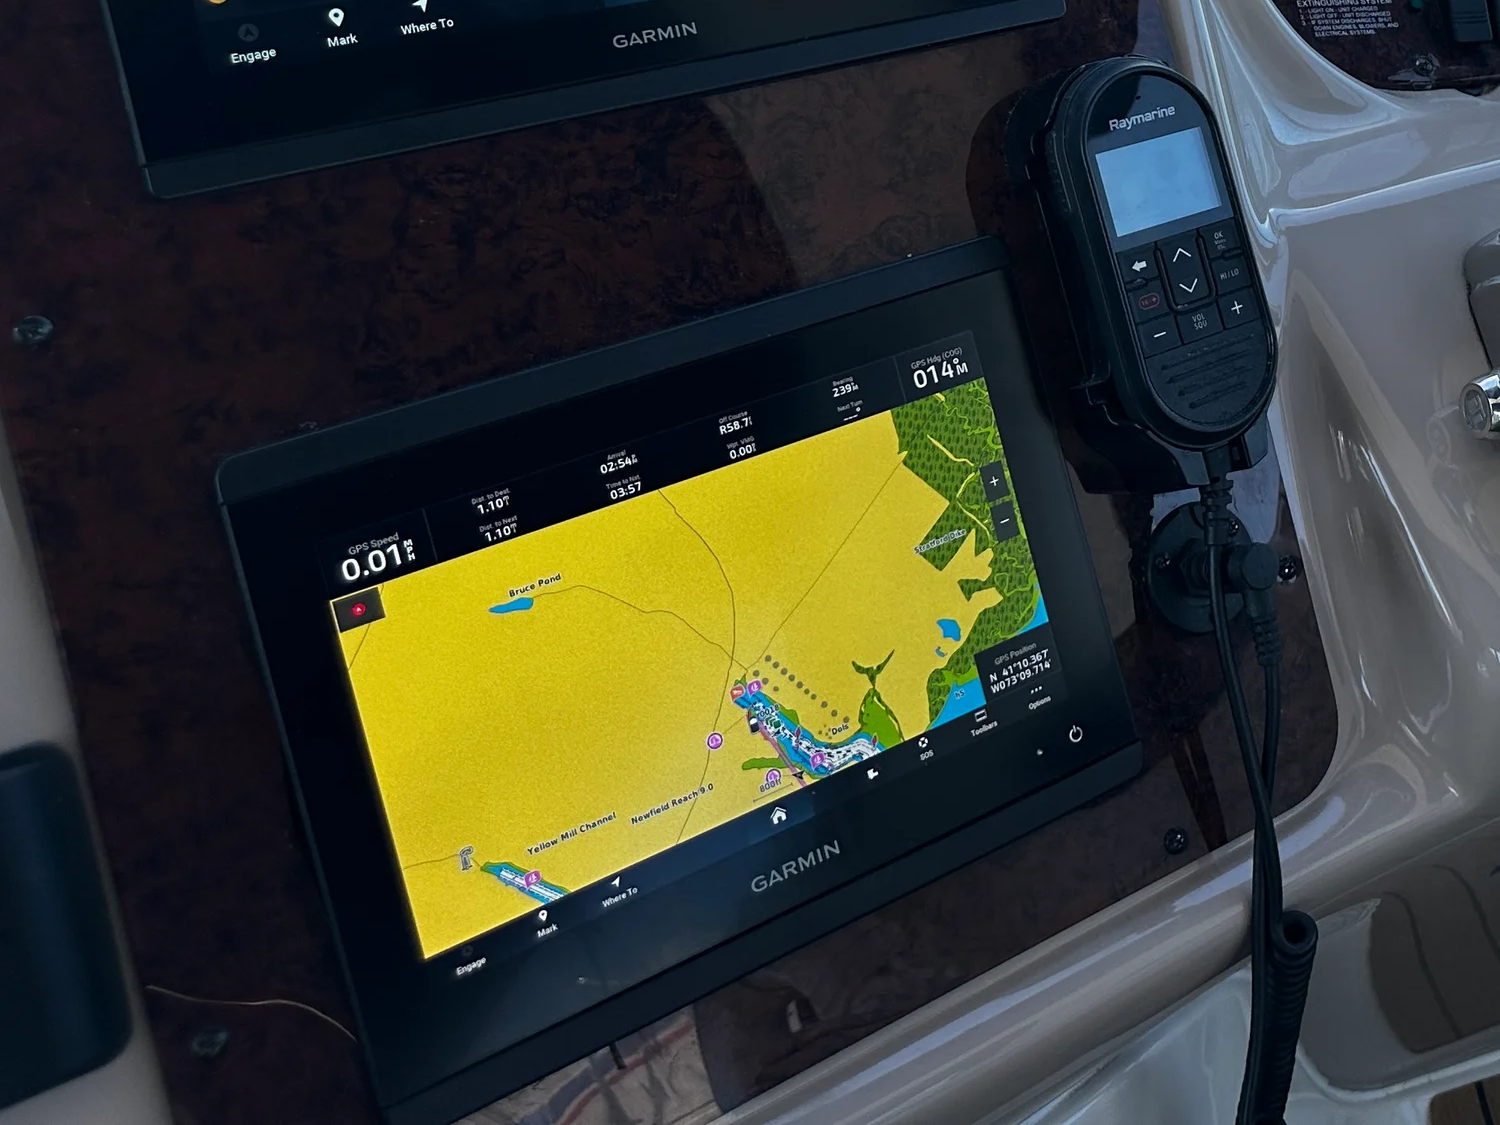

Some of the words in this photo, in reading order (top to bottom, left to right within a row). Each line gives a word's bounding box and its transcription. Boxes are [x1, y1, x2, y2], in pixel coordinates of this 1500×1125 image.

[401, 22, 437, 35] Where
[438, 18, 454, 28] To
[612, 22, 698, 48] GARMIN
[327, 33, 358, 47] Mark
[231, 48, 277, 64] Engage
[1109, 104, 1176, 131] Raymarine
[1214, 231, 1223, 239] OK
[1192, 313, 1205, 322] VOL
[1194, 320, 1208, 330] SQU
[911, 359, 926, 370] GPS
[927, 355, 942, 366] Hdg
[942, 347, 962, 362] (COG)
[600, 456, 632, 474] 02:54
[610, 481, 642, 500] 03:57
[348, 542, 369, 555] GPS
[370, 532, 399, 550] Speed
[914, 536, 949, 554] Stratford
[950, 529, 966, 539] Dike
[341, 543, 402, 581] 0.01
[508, 582, 535, 598] Bruce
[538, 573, 562, 587] Pond
[995, 653, 1009, 665] GPS
[1009, 642, 1036, 659] Position
[990, 673, 998, 682] N
[1028, 695, 1051, 710] Options
[832, 723, 849, 735] Dols
[970, 720, 998, 737] Toolbars
[920, 749, 934, 760] SOS
[631, 802, 670, 825] Newfield
[671, 790, 698, 808] Reach
[699, 783, 714, 795] 9.0
[527, 838, 558, 856] Yellow
[560, 828, 578, 842] Mill
[579, 811, 617, 834] Channel
[750, 839, 841, 893] GARMIN
[602, 891, 627, 908] Where
[627, 886, 638, 897] To
[537, 923, 558, 938] Mark
[456, 956, 487, 976] Engage
